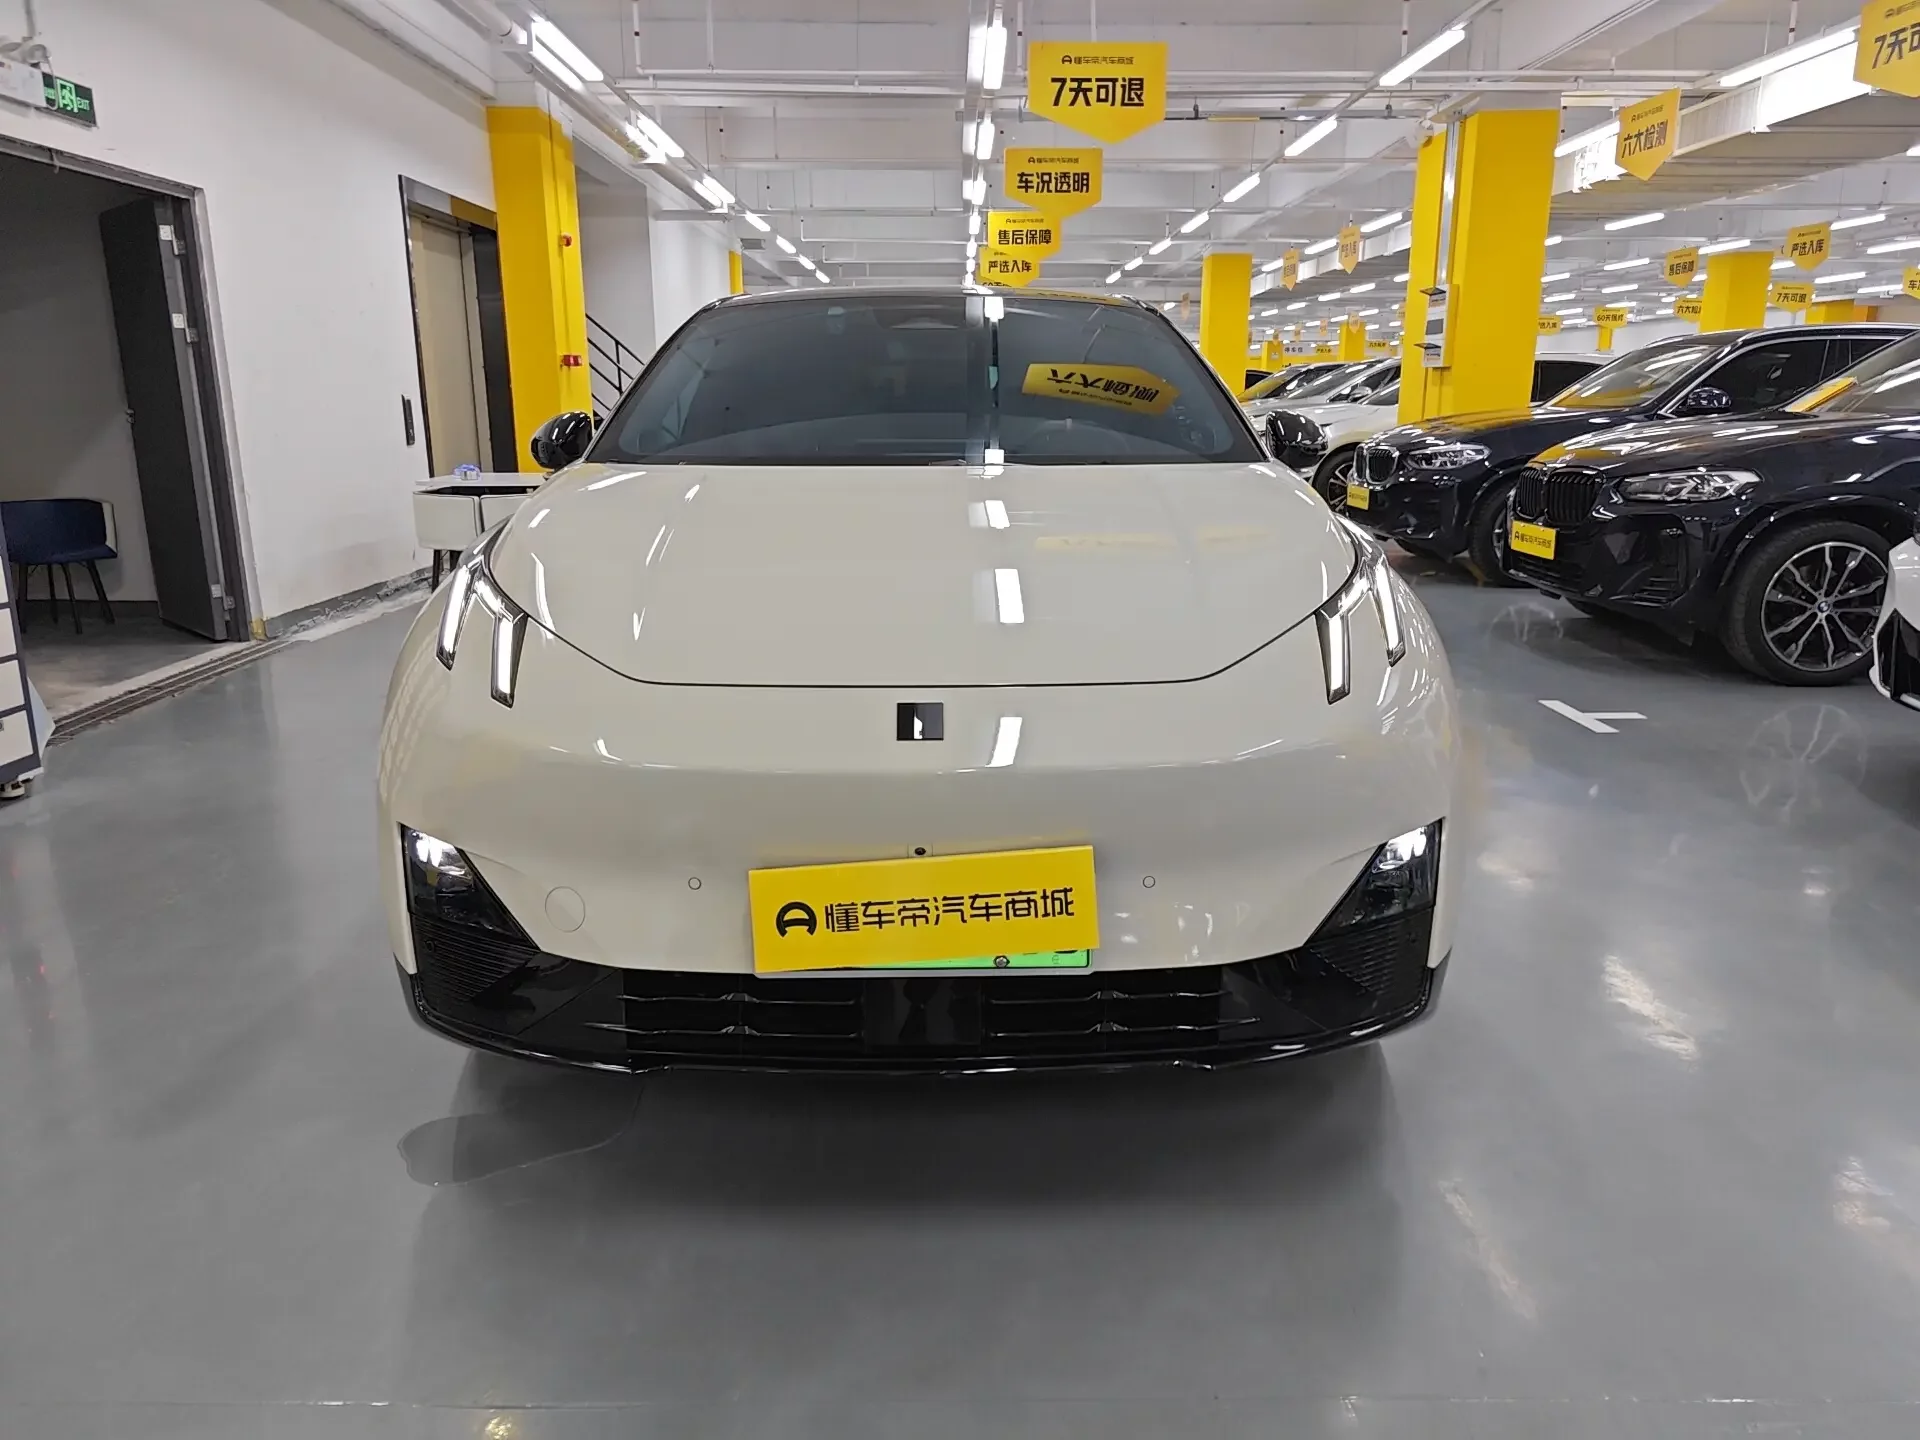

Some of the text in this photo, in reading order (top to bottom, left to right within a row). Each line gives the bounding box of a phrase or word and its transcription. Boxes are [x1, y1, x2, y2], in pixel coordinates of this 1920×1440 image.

[1050, 77, 1145, 107] 7天可退
[1621, 119, 1668, 159] 六大检测
[1017, 171, 1090, 193] 车况透明
[998, 229, 1052, 245] 售后保障
[1790, 239, 1825, 257] 严选入库
[988, 259, 1032, 273] 严选入库
[1908, 280, 1920, 291] 车
[1776, 293, 1807, 303] 7天可退
[824, 887, 1075, 933] 懂车帝汽车商城
